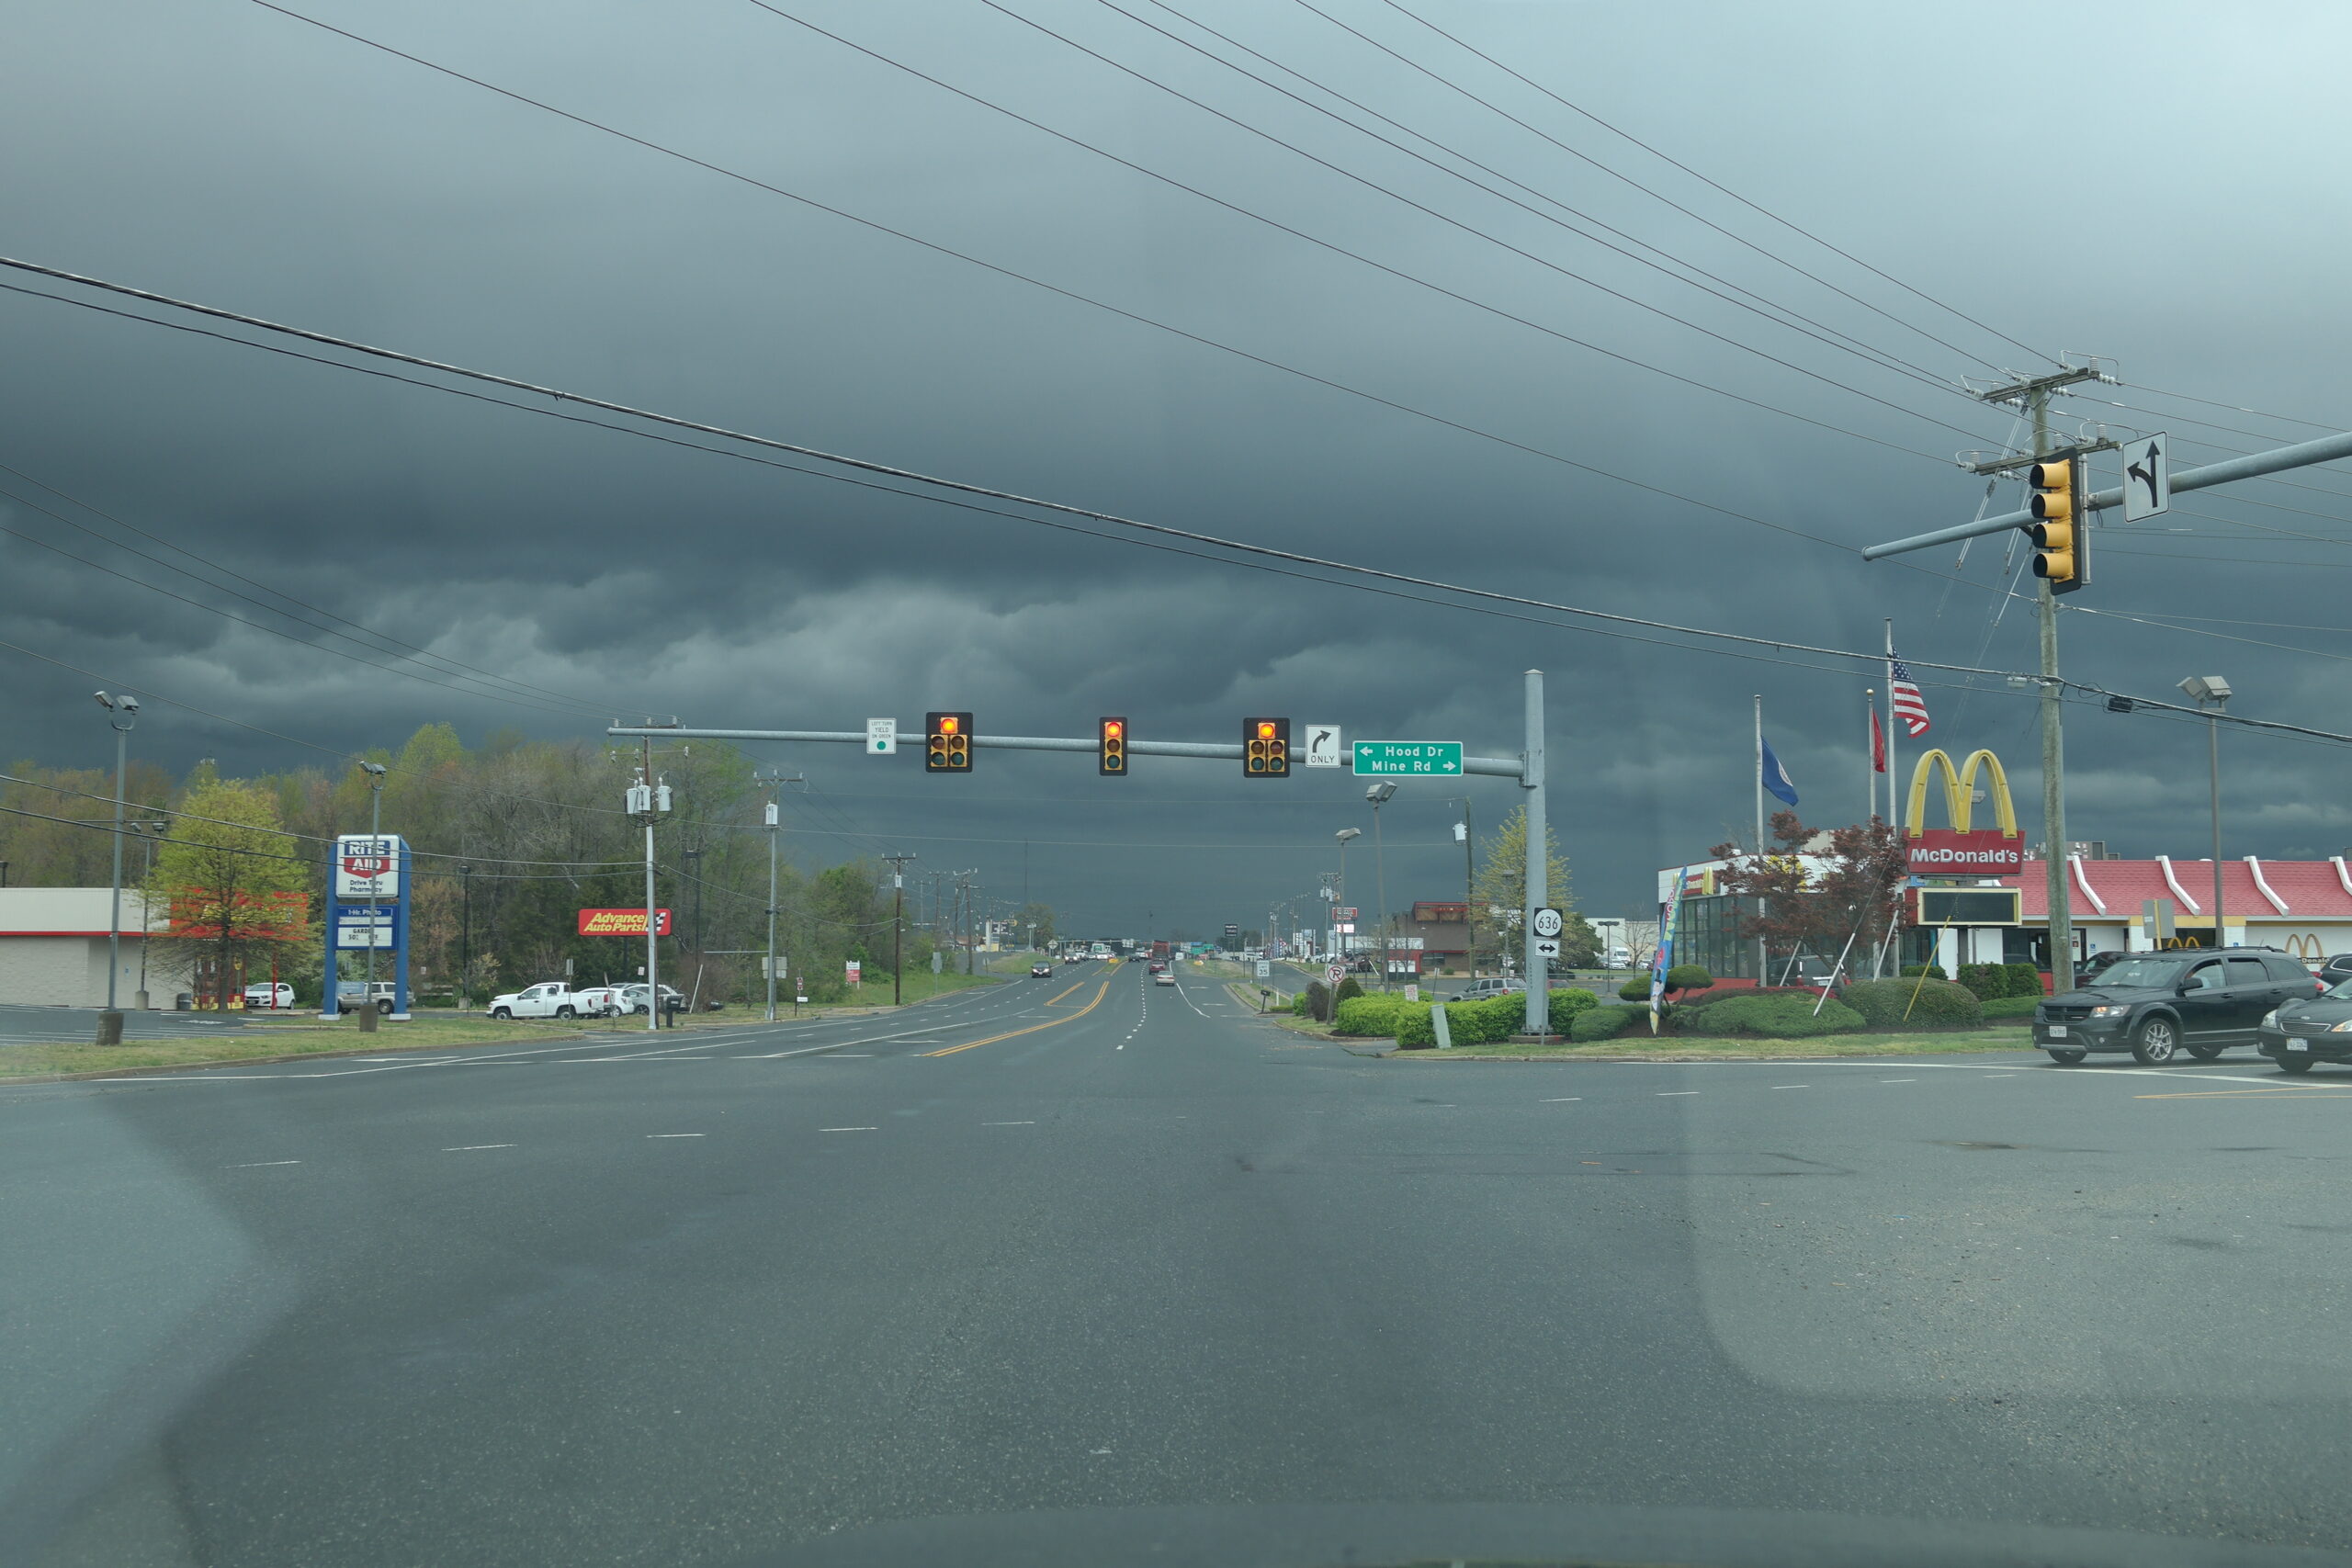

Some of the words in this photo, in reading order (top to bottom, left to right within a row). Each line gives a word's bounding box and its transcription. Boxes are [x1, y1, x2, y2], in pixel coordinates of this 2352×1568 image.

[1385, 746, 1420, 757] Hood
[1427, 746, 1444, 757] Dr
[1310, 755, 1335, 763] ONLY
[1372, 761, 1407, 772] Mine
[1413, 761, 1431, 772] Rd
[349, 840, 385, 855] RITE
[1910, 848, 2018, 863] McDonald's
[351, 858, 382, 871] AID
[590, 912, 645, 923] Advance
[1538, 916, 1558, 930] 636
[583, 922, 608, 931] Auto
